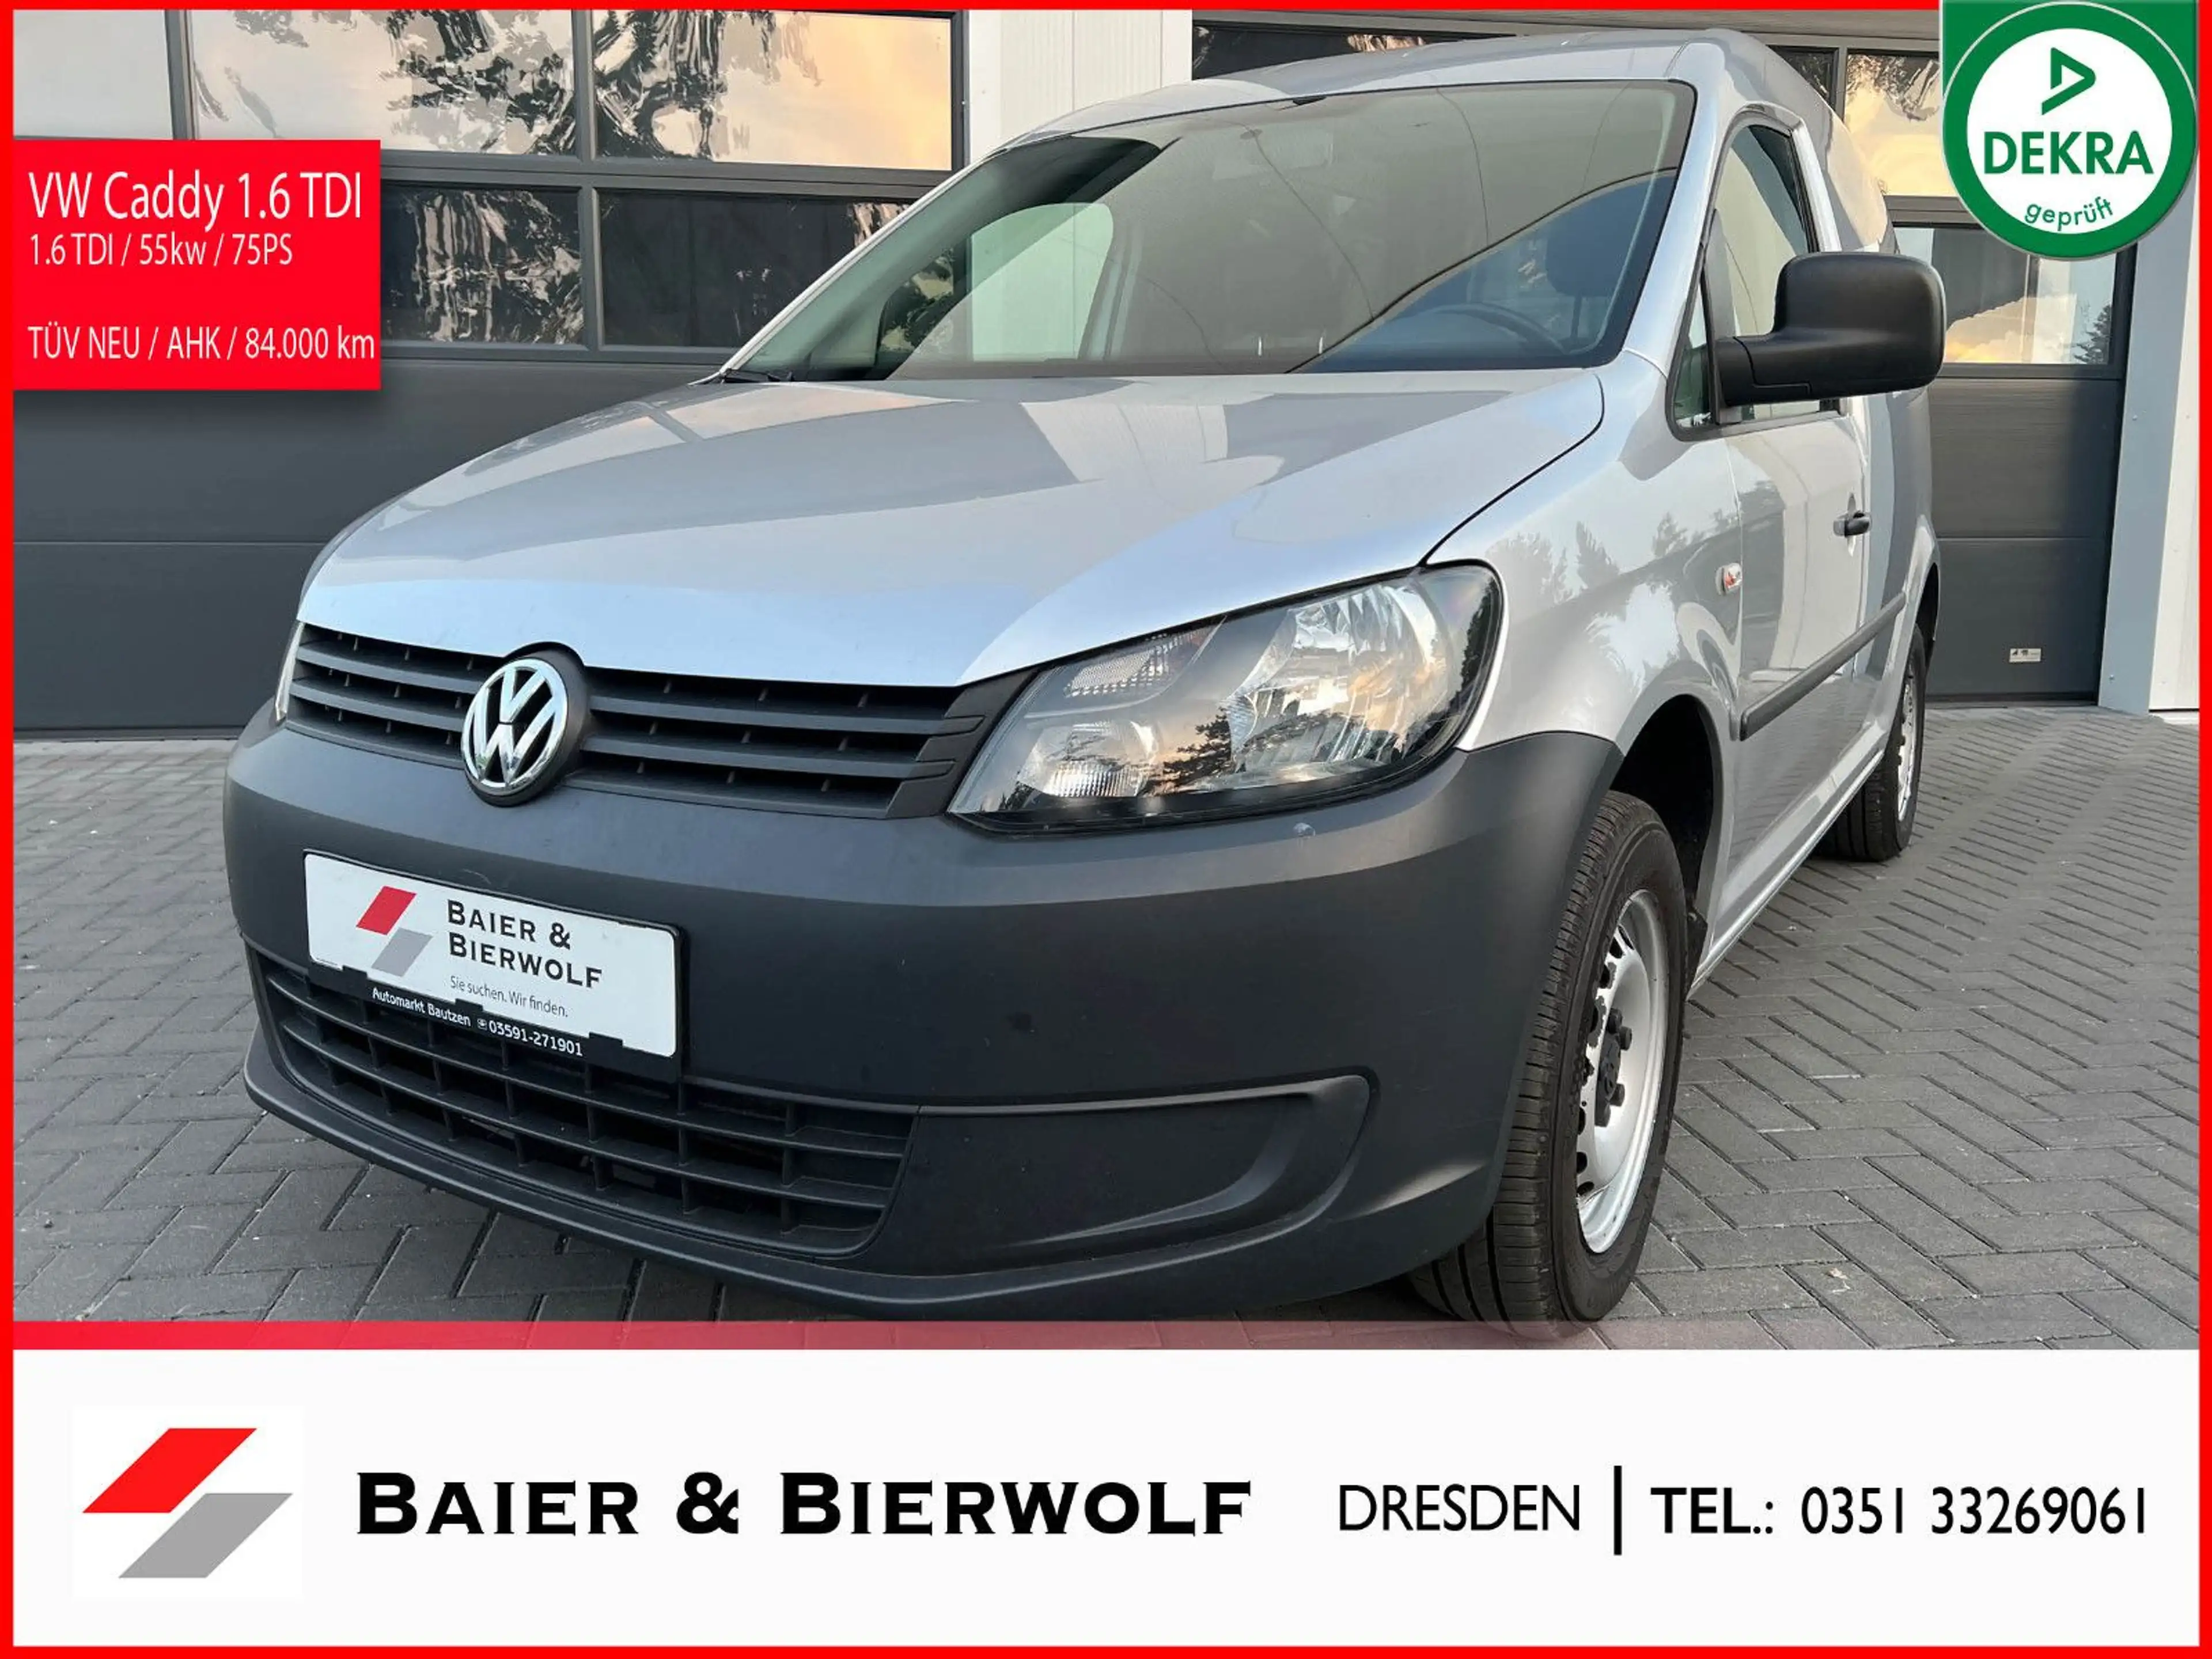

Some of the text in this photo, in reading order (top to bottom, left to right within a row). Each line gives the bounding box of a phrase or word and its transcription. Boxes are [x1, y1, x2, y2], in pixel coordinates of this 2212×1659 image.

[447, 899, 570, 950] BAIER &
[449, 931, 603, 988] BIERWOLF
[372, 987, 584, 1057] Automarkt Bautzen 03591-271901
[450, 975, 569, 1018] Sie suchen. Wir finden.
